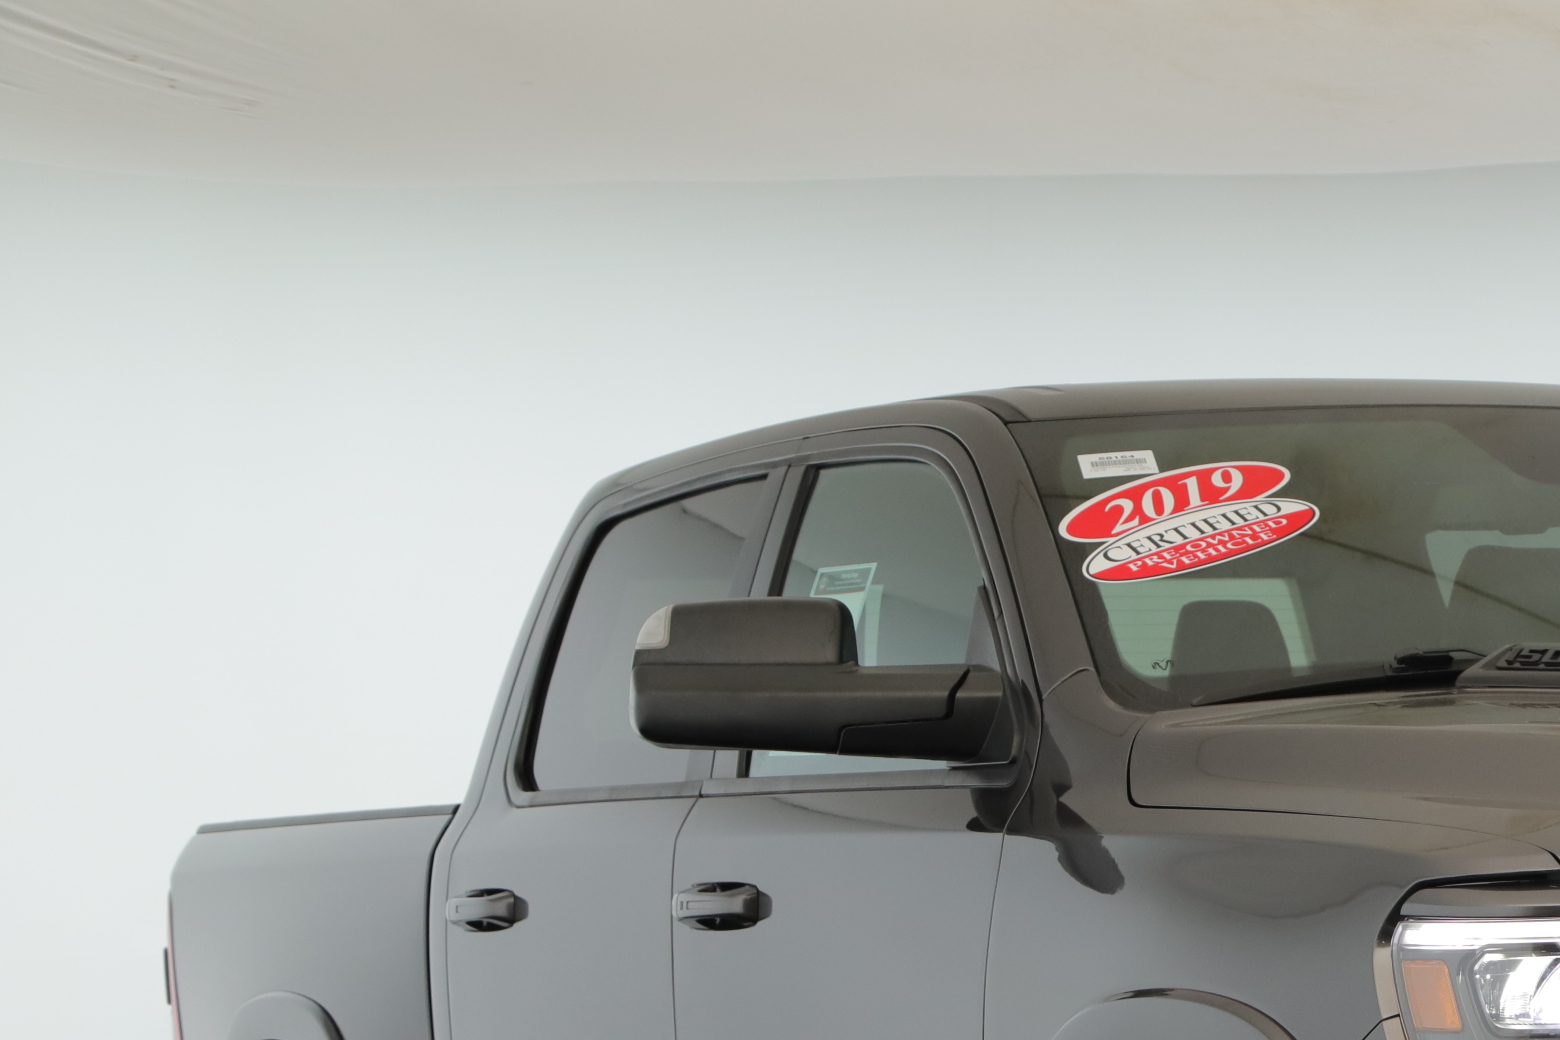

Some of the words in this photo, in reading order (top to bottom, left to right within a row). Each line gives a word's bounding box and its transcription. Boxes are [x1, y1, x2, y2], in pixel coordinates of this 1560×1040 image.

[1104, 467, 1244, 535] 2019
[1102, 501, 1282, 563] CERTIFIED
[1126, 517, 1288, 572] PRE-OWNED
[1159, 530, 1277, 570] VEHICLE
